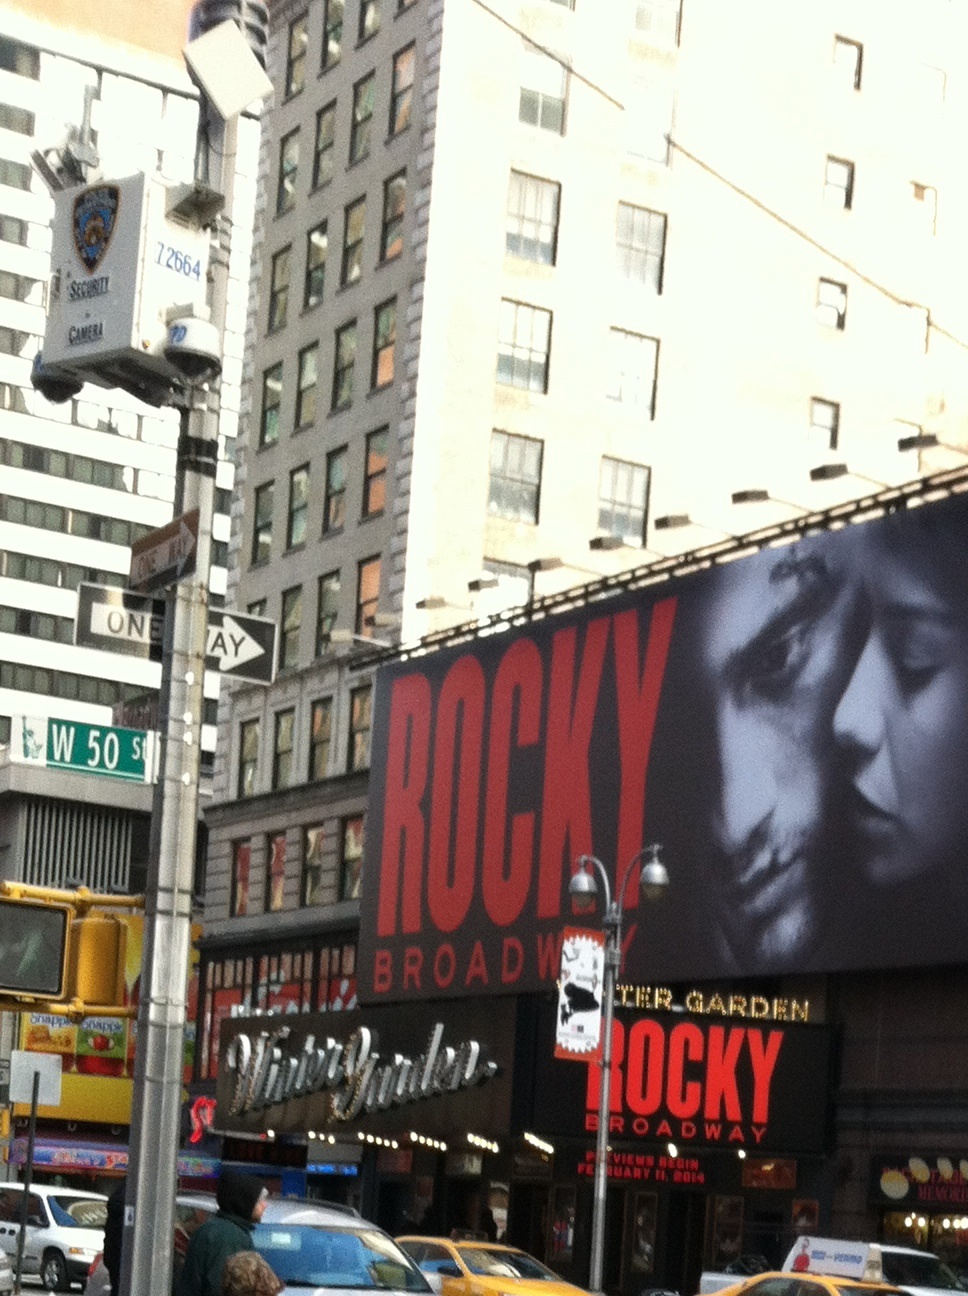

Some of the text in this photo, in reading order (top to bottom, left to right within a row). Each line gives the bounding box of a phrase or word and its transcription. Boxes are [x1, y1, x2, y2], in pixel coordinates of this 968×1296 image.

[156, 241, 202, 283] 72664
[106, 610, 246, 659] ONE AY
[52, 723, 75, 763] W
[87, 729, 120, 770] 50
[376, 596, 679, 937] ROCKY
[373, 924, 639, 994] BROADWY
[30, 1011, 74, 1029] Snappl
[685, 988, 810, 1023] GARDEN
[585, 1018, 785, 1125] ROCKY
[584, 1112, 767, 1145] BROADWAY
[576, 1162, 652, 1180] FERUARY
[585, 1150, 655, 1167] PEVIEWS
